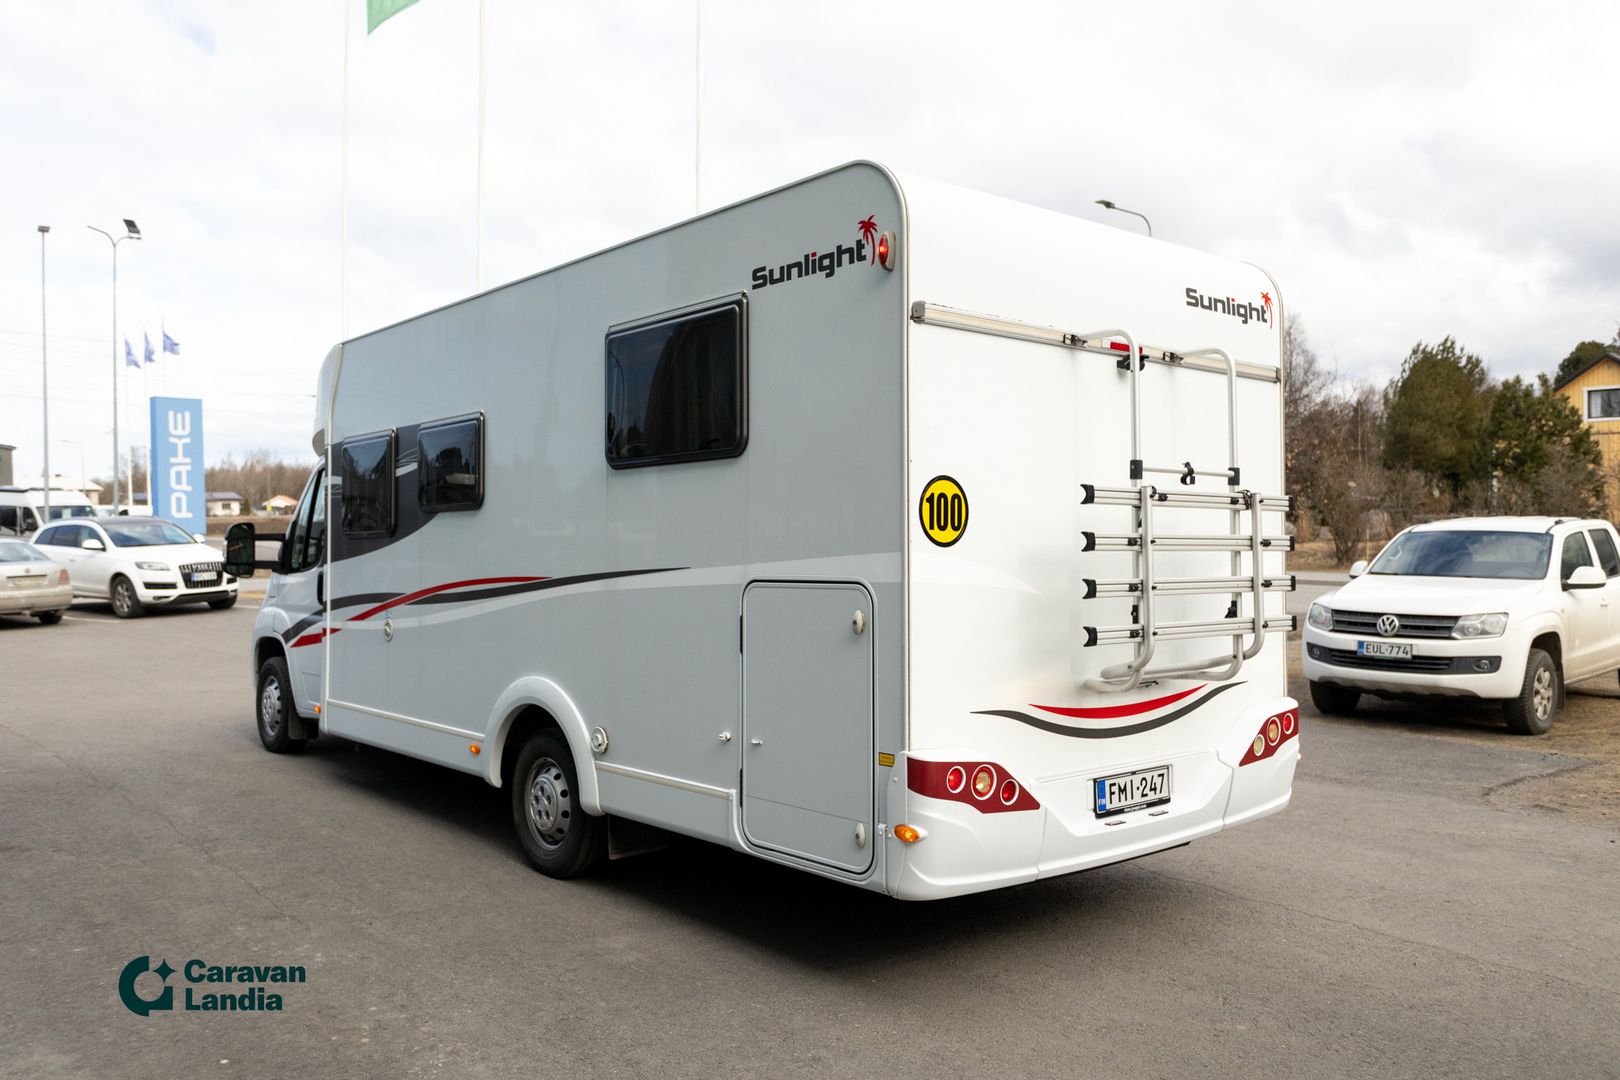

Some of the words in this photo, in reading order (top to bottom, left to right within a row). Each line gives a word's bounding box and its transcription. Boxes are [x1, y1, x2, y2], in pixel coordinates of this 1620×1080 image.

[752, 238, 867, 290] Sunlight
[1185, 287, 1268, 325] Sunlight
[925, 492, 963, 532] 100
[1109, 773, 1165, 805] FMI-247
